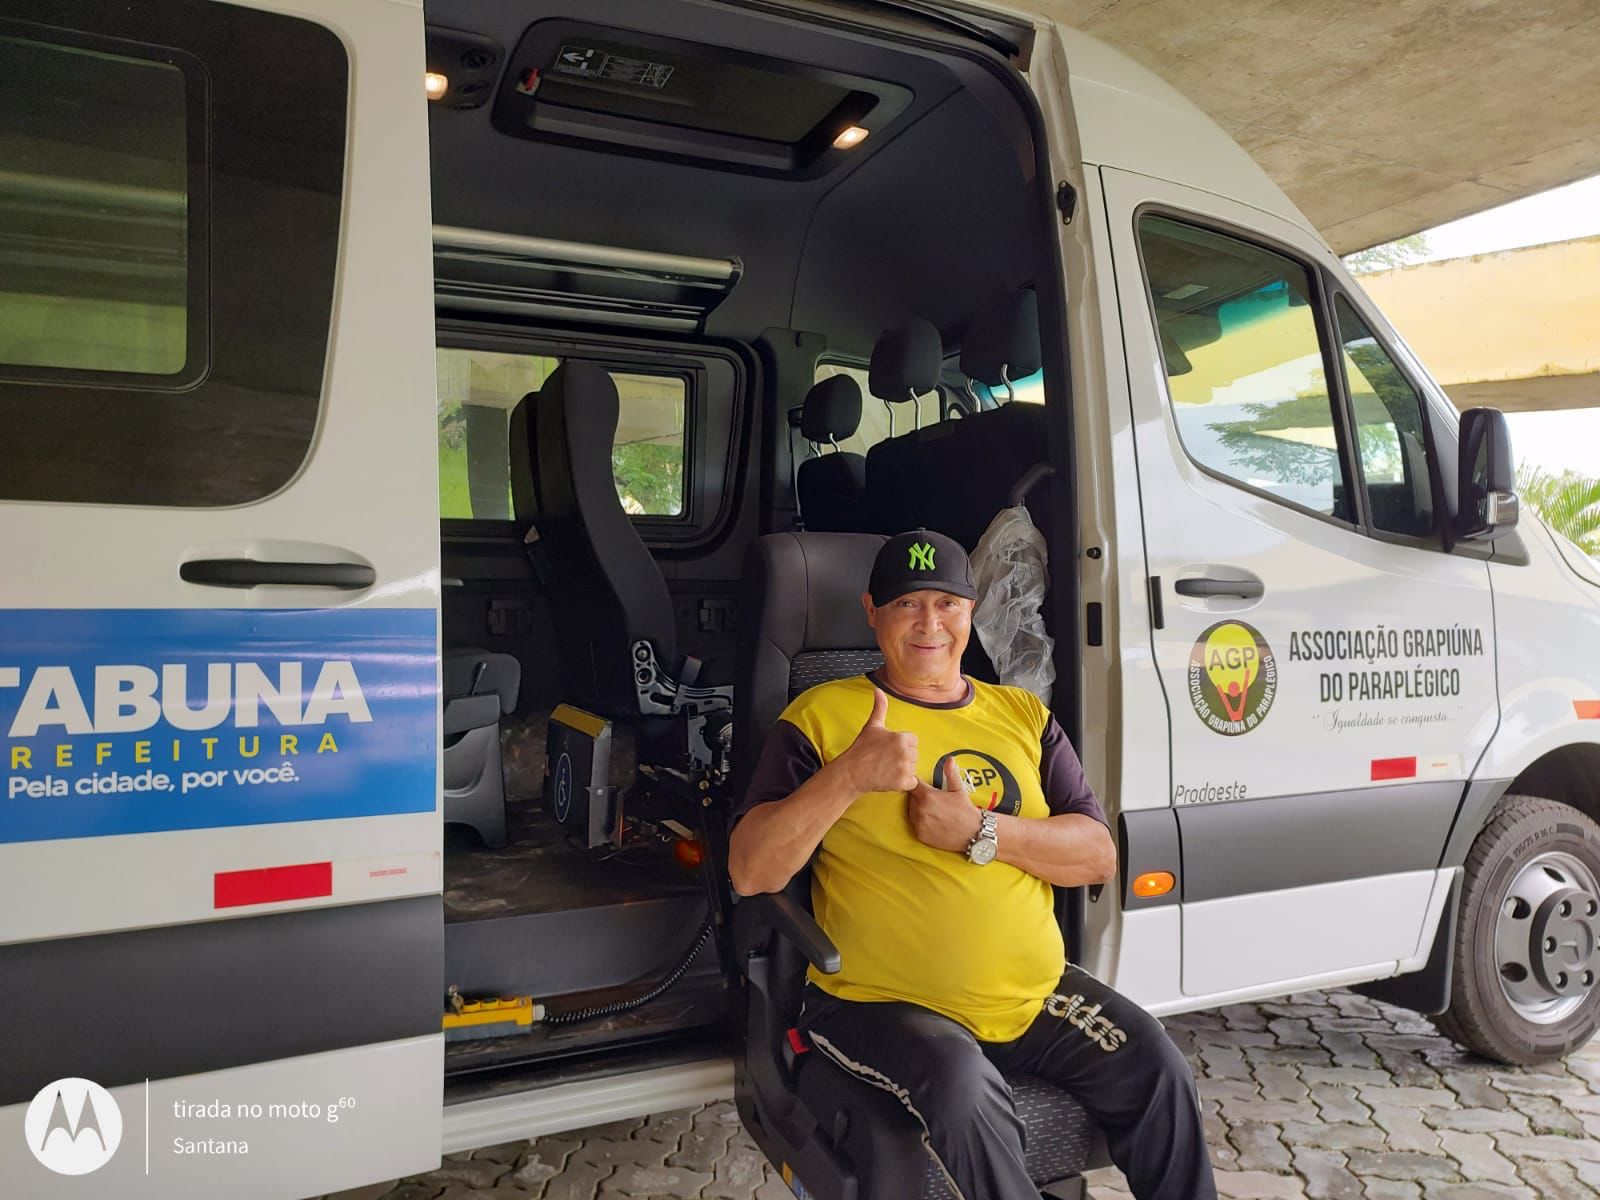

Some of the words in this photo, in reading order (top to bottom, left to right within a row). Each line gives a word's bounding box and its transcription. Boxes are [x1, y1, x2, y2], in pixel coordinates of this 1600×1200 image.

[1209, 646, 1256, 671] AGP
[1289, 624, 1398, 664] ASSOCIAÇÃO
[1403, 622, 1483, 658] GRAPIÚNA
[1320, 672, 1343, 702] DO
[1348, 663, 1460, 701] PARAPLÉGICO
[1246, 713, 1259, 728] DO
[8, 775, 69, 799] Pela
[74, 768, 175, 795] cidade,
[181, 769, 228, 794] por
[233, 761, 300, 785] você.
[1174, 780, 1248, 804] Prodoeste
